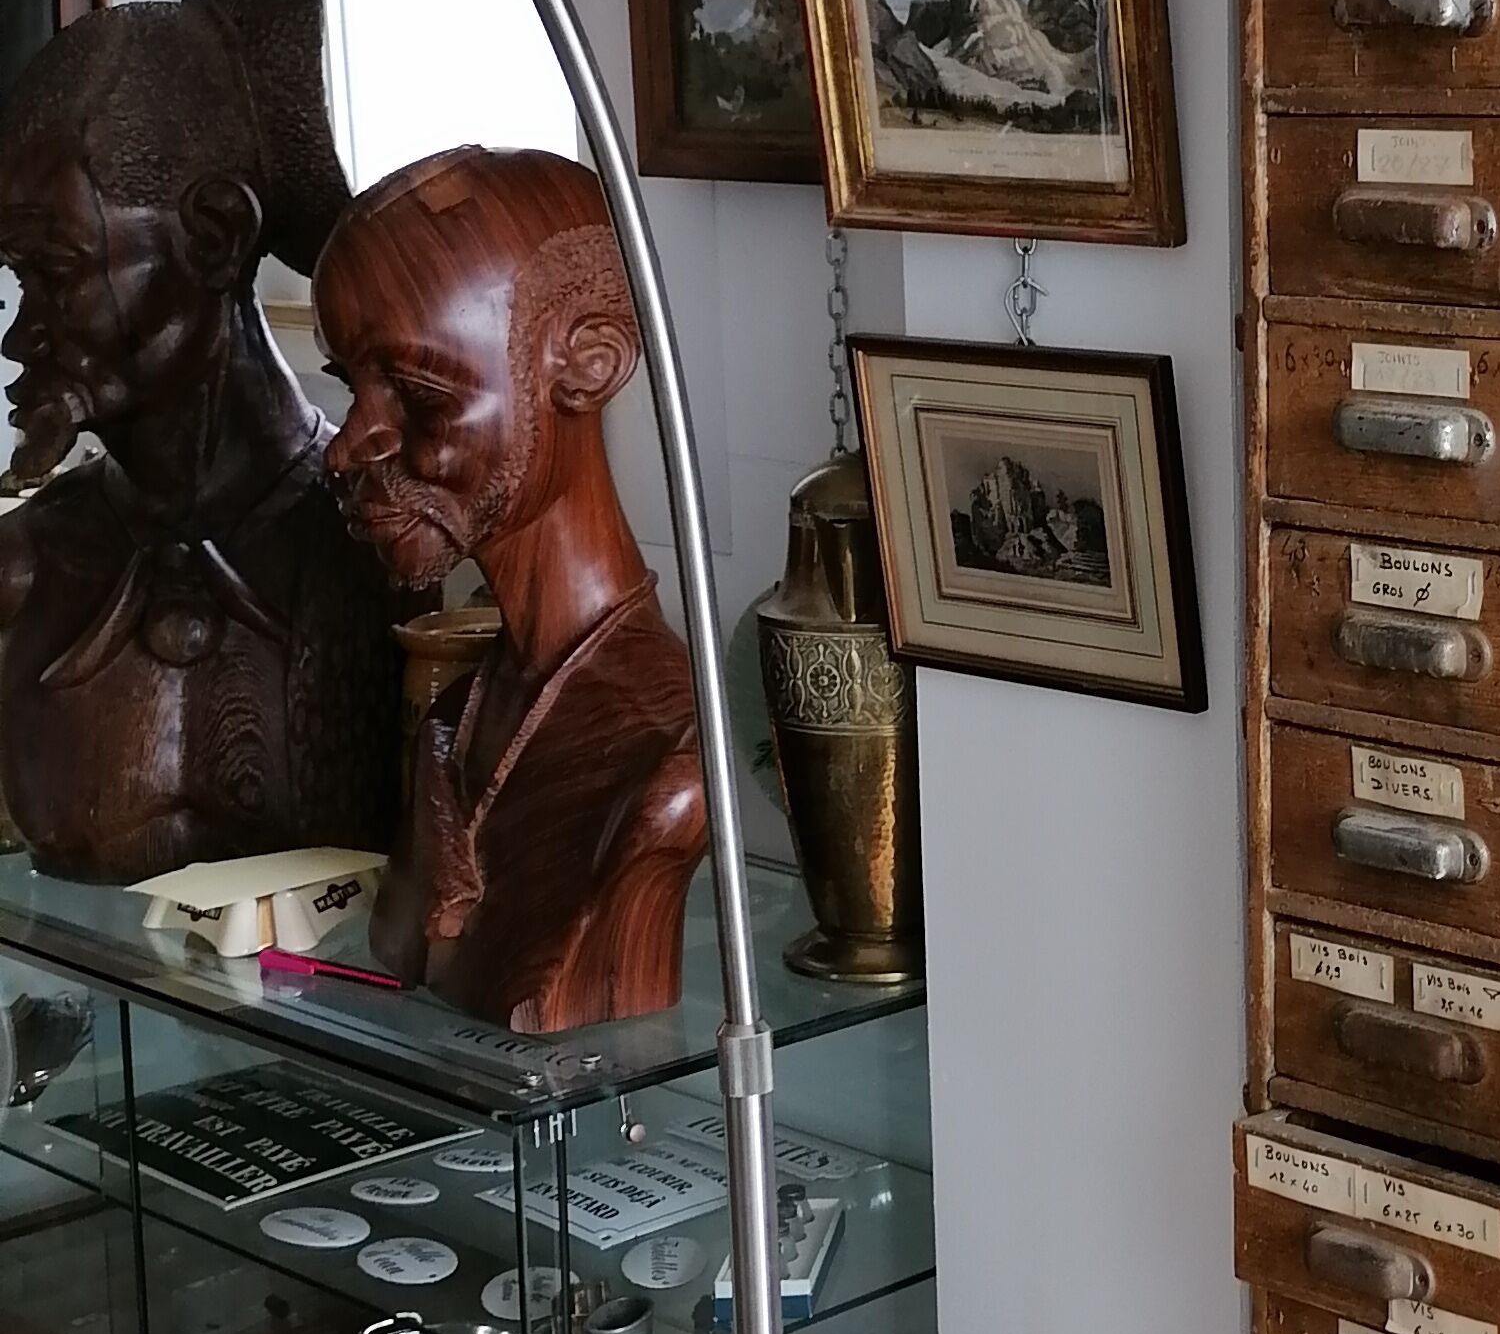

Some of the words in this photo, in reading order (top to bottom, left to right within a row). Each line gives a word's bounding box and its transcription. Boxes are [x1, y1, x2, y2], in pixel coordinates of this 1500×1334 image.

[1379, 552, 1454, 578] BOULONS
[1372, 581, 1404, 599] GROS
[1309, 943, 1330, 957] VIS
[1425, 973, 1444, 989] VIS
[136, 1117, 279, 1193] TRAVAILLER
[243, 1136, 318, 1172] PAYÉ
[1264, 1144, 1330, 1177] BOULONS
[1384, 1178, 1406, 1196] VIS
[1456, 1223, 1475, 1240] 30
[1409, 1301, 1435, 1320] VIS
